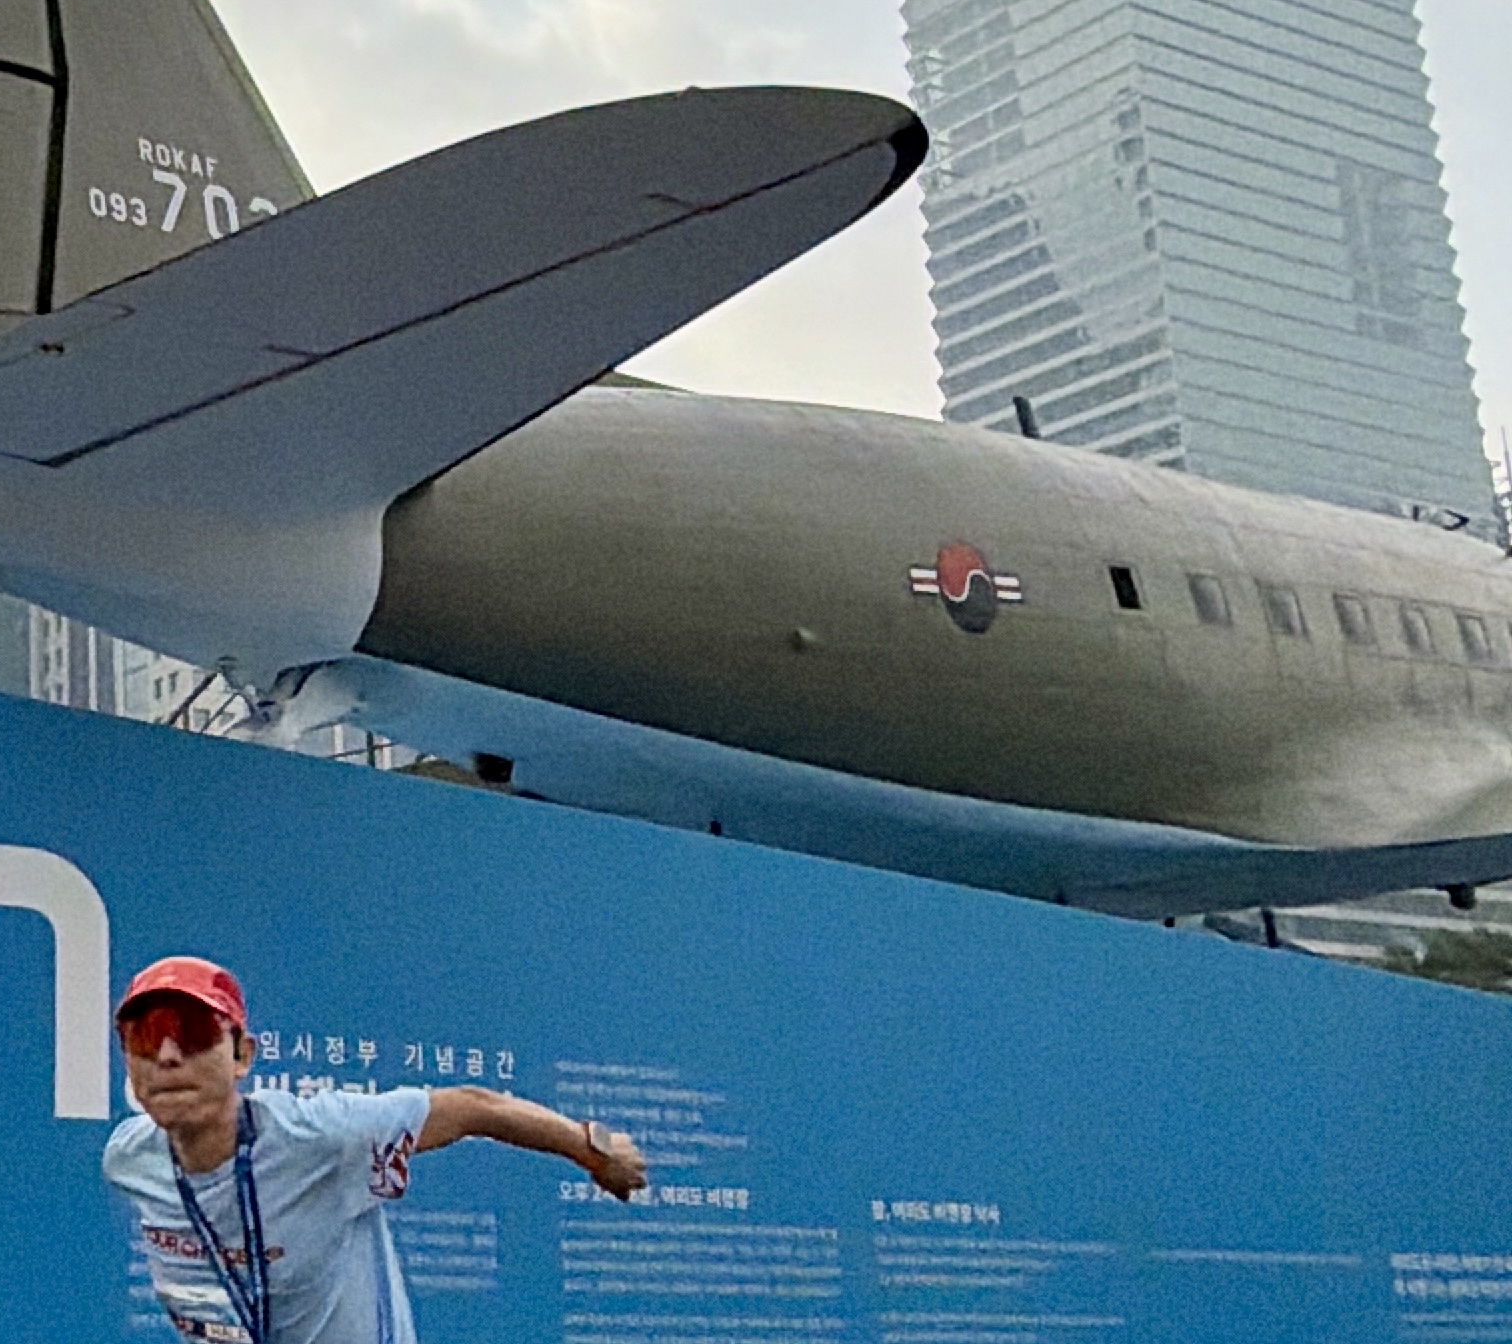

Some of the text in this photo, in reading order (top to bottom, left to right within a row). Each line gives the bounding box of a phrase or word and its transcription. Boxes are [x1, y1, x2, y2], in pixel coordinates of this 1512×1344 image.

[138, 137, 217, 178] ROKAF
[152, 168, 277, 239] 70
[260, 1031, 515, 1080] 임시정부 기념공간
